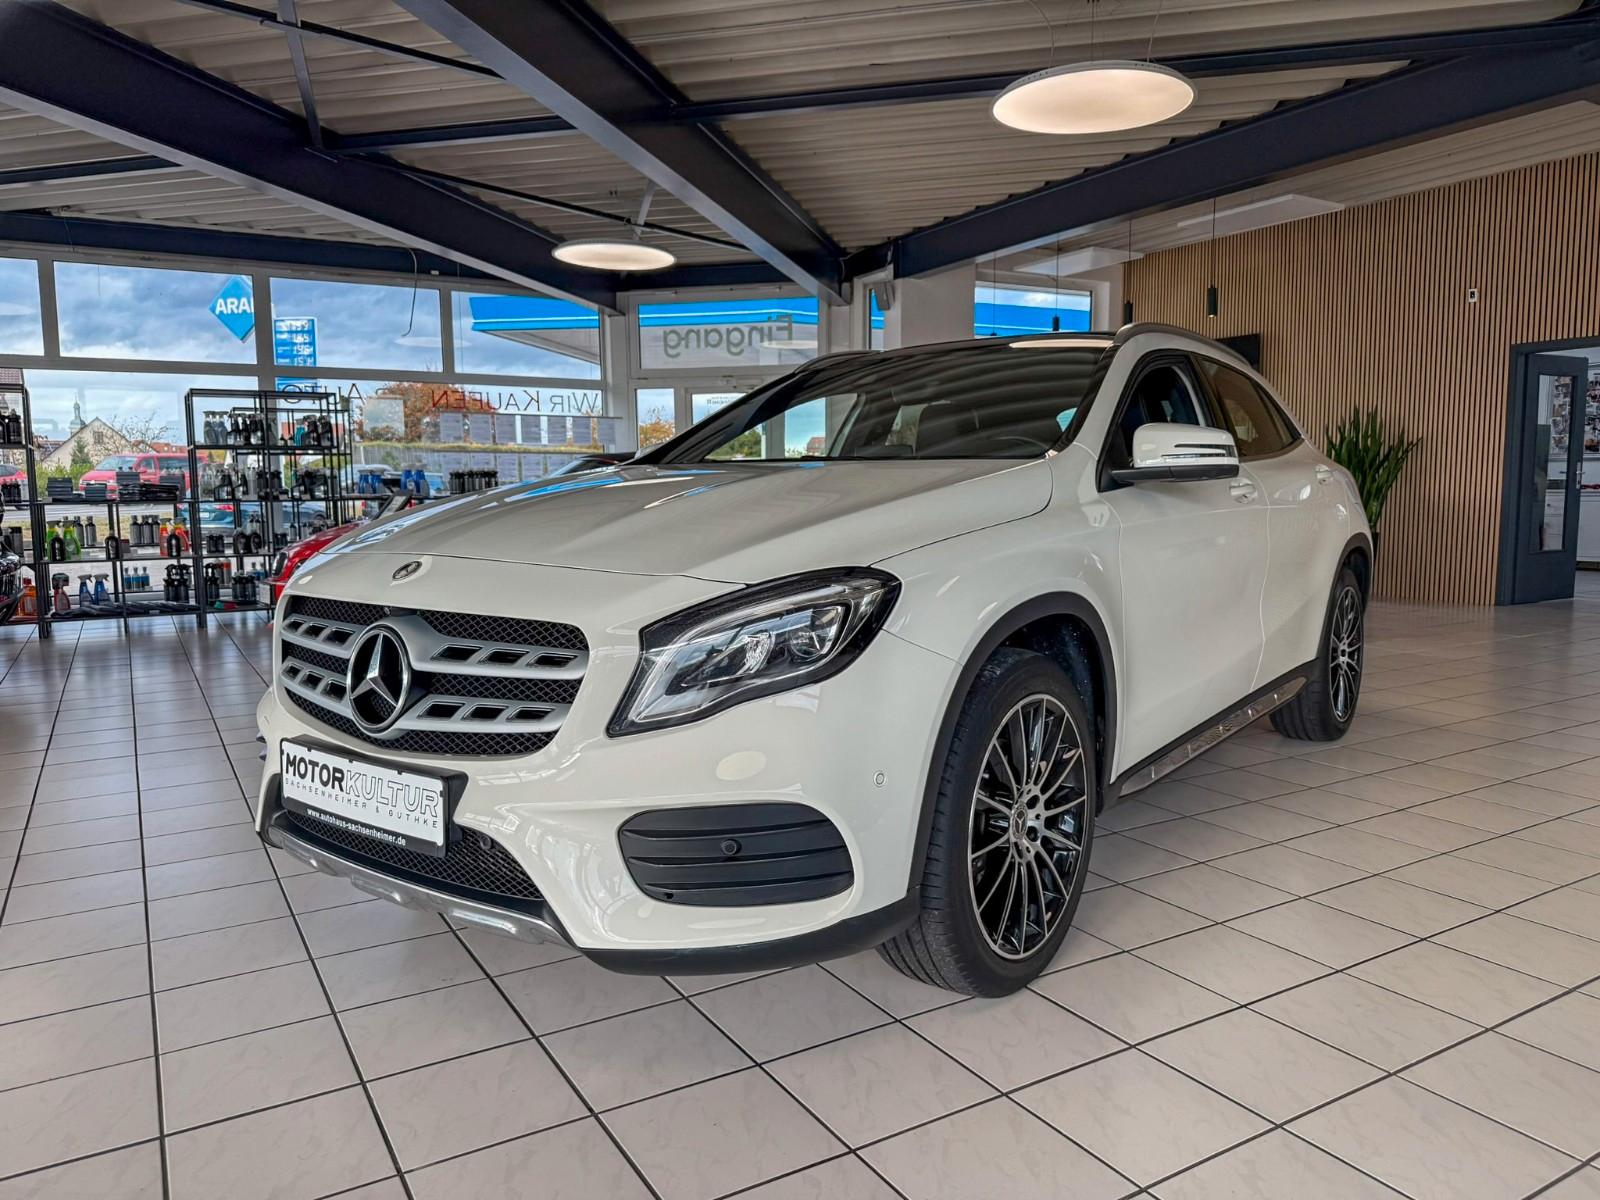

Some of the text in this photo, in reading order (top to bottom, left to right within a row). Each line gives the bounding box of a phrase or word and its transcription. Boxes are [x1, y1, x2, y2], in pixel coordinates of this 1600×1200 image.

[285, 751, 439, 818] MOTORKULTUR
[285, 777, 367, 809] SACHSENHEIMER
[388, 809, 439, 829] GUTHKE
[306, 807, 406, 846] www.autohaus-sachsenheimer.de
